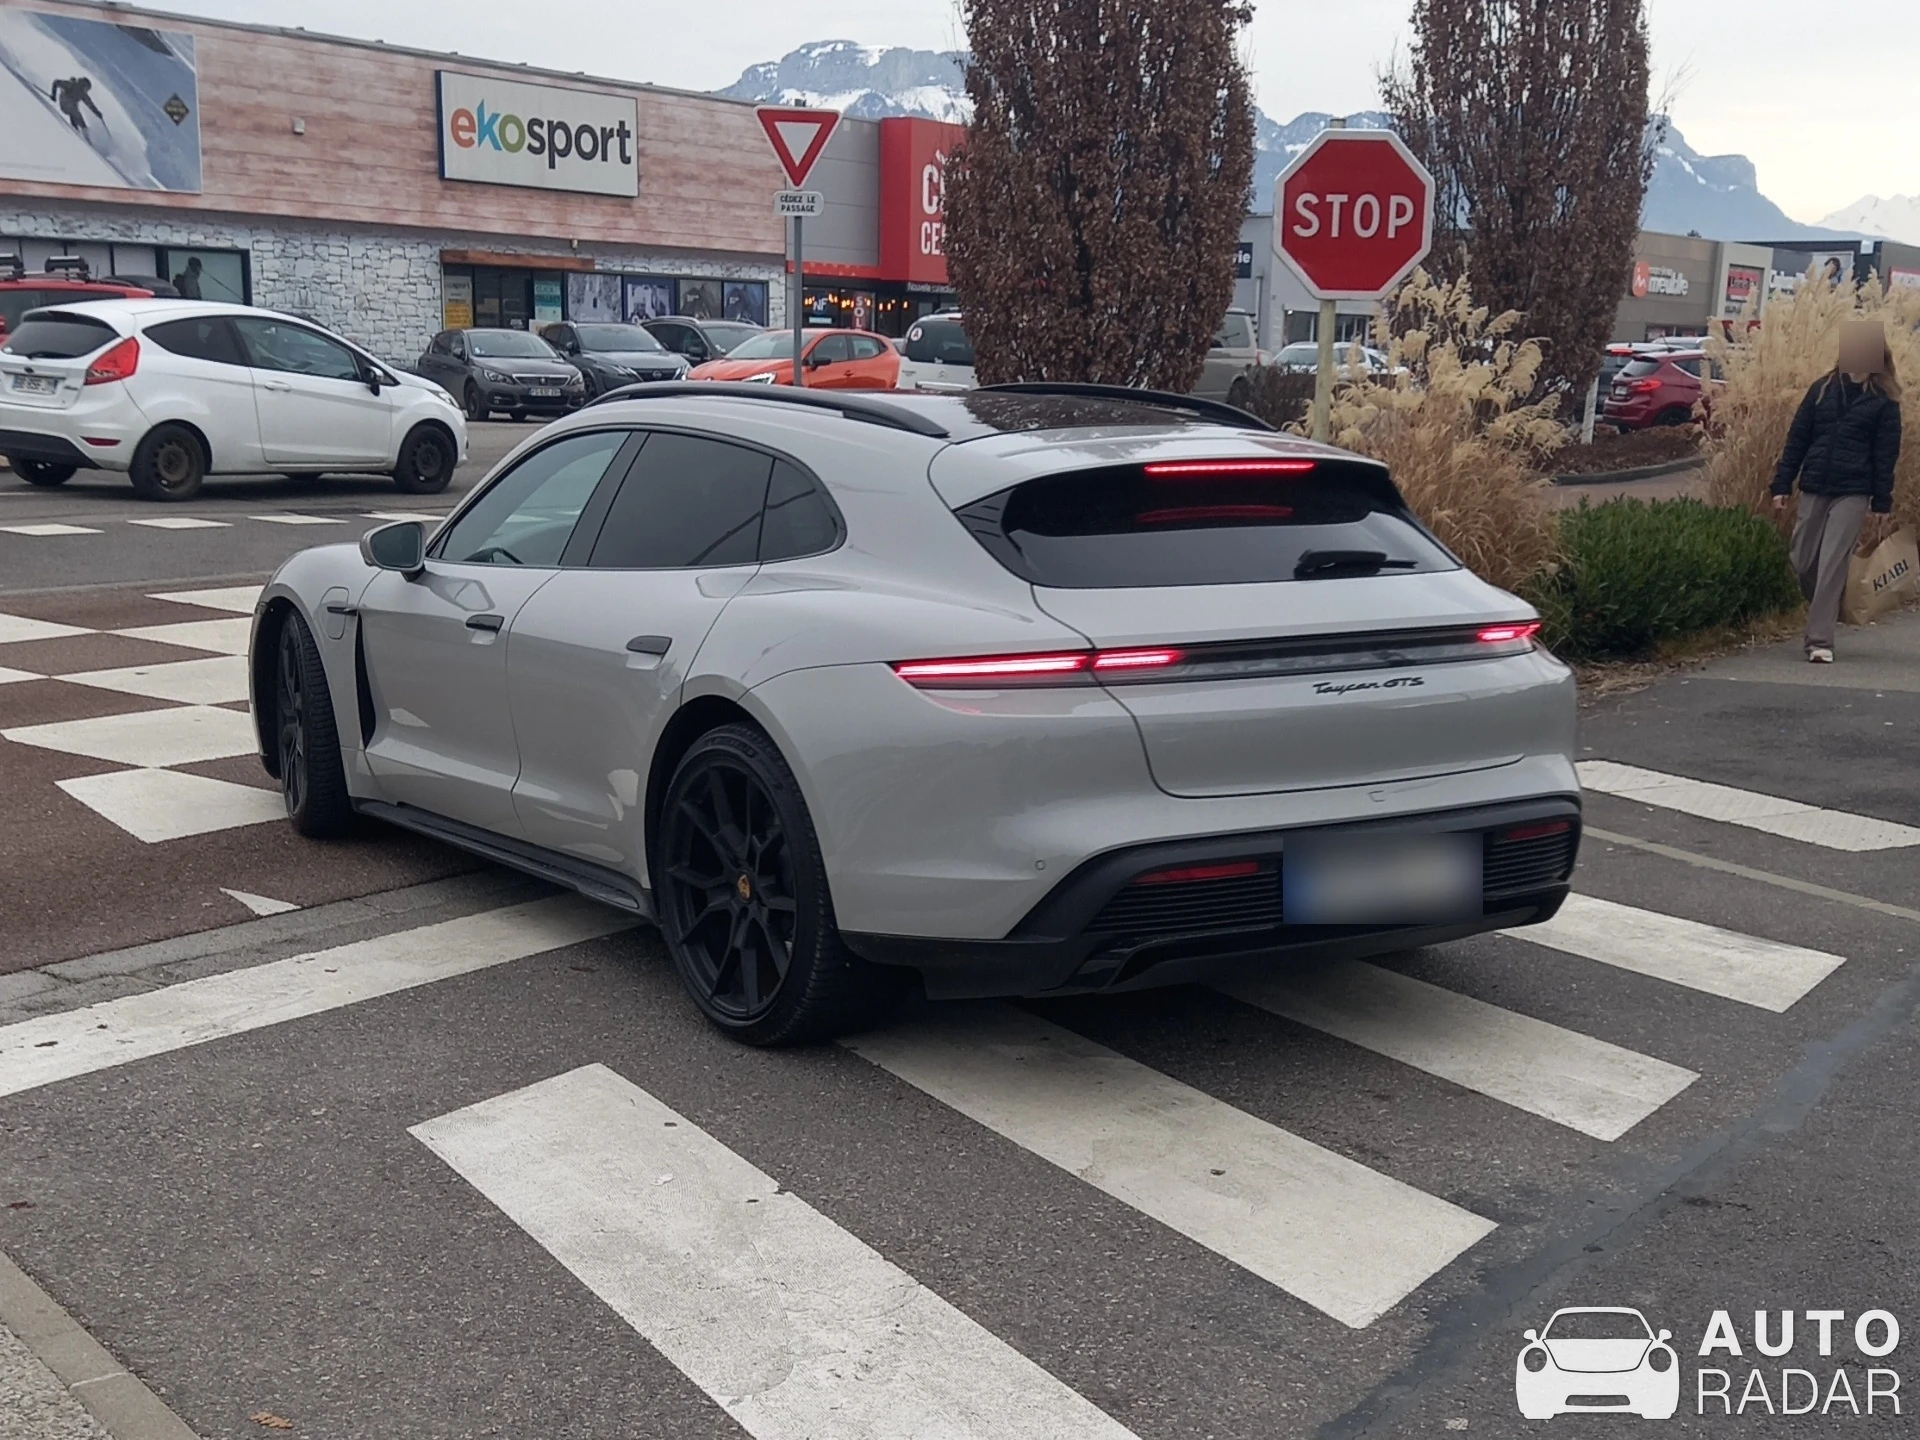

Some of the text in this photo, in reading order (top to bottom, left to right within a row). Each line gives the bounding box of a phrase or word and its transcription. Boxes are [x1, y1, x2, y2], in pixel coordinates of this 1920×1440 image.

[450, 98, 632, 170] ekosport
[780, 194, 816, 204] CÉDEZ LE
[781, 204, 815, 212] PASSAGE
[1292, 193, 1414, 239] STOP
[1647, 272, 1689, 296] meuble
[1872, 558, 1909, 592] KIABI
[1312, 676, 1425, 696] Taycan GTS
